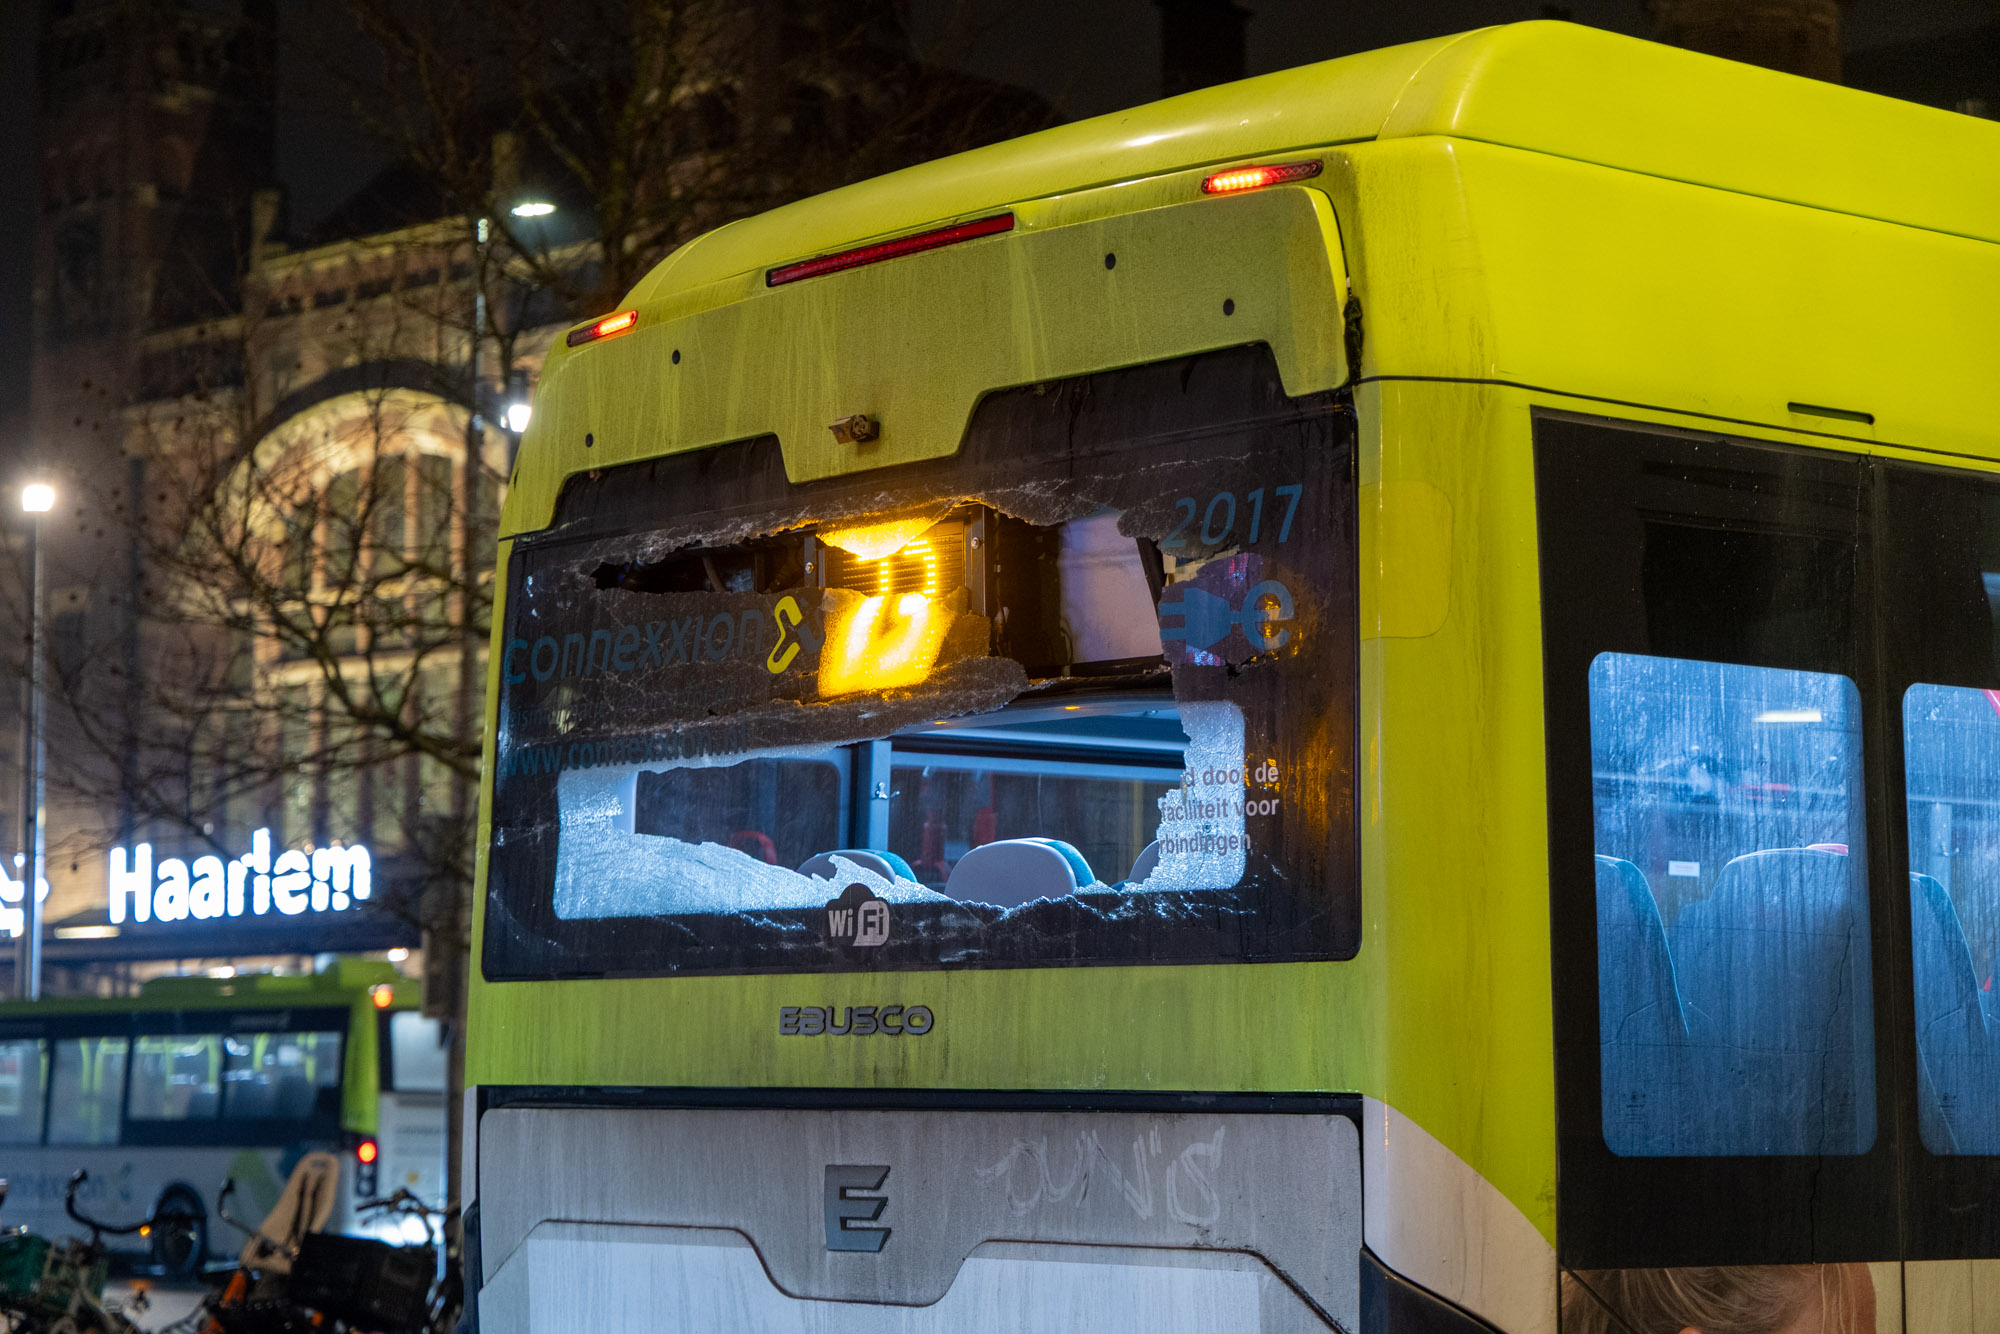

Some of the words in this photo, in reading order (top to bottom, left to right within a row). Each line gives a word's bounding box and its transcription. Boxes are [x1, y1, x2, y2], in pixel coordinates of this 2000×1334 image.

[1160, 484, 1303, 549] 2017
[504, 609, 764, 685] connexxion
[506, 722, 747, 776] www.connexxion.nl
[1203, 765, 1250, 787] door
[1255, 762, 1280, 783] de
[1234, 798, 1280, 818] voor
[108, 826, 373, 925] Haarlem
[778, 1005, 934, 1036] EBUSCO
[824, 1163, 892, 1253] E
